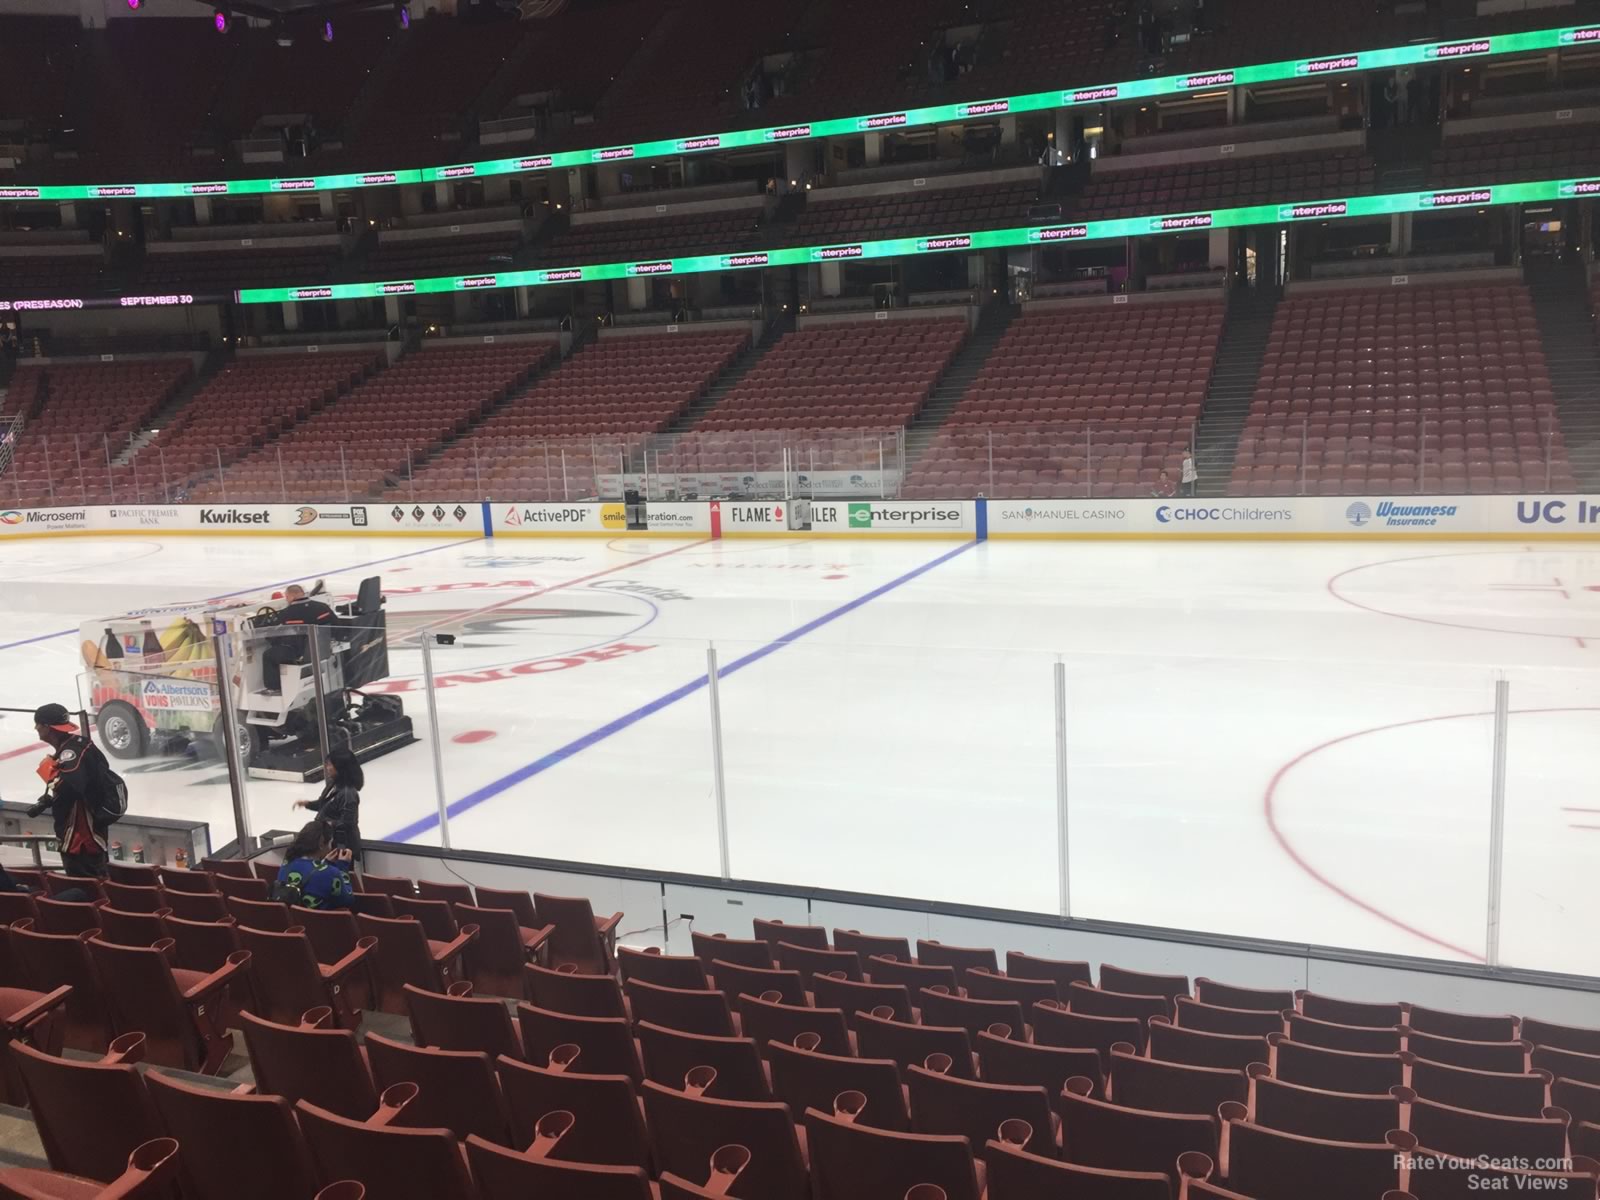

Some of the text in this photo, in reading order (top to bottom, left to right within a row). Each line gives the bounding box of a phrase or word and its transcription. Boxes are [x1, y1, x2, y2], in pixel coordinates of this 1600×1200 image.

[1561, 29, 1600, 42] enter
[0, 189, 39, 199] nterprise
[14, 299, 83, 310] (PRESEASON)
[121, 295, 193, 306] SEPTEMBER 30
[118, 509, 179, 518] PACIFIC PREMIER
[394, 508, 464, 518] K C D S
[523, 508, 587, 522] ActivePDF
[732, 507, 837, 522] FLAME ILER
[1002, 510, 1125, 520] SAN MANUEL CASINO
[1376, 501, 1457, 517] Wawanesa
[1517, 501, 1566, 524] UC
[26, 509, 86, 523] Microsemi
[140, 517, 160, 525] BANK
[200, 509, 270, 523] Kwikset
[603, 511, 693, 521] smileeration.com
[852, 507, 960, 524] enterprise
[1386, 517, 1437, 527] Insurance
[161, 684, 209, 696] Albertsons
[145, 695, 210, 709] VONS PAVILIONS
